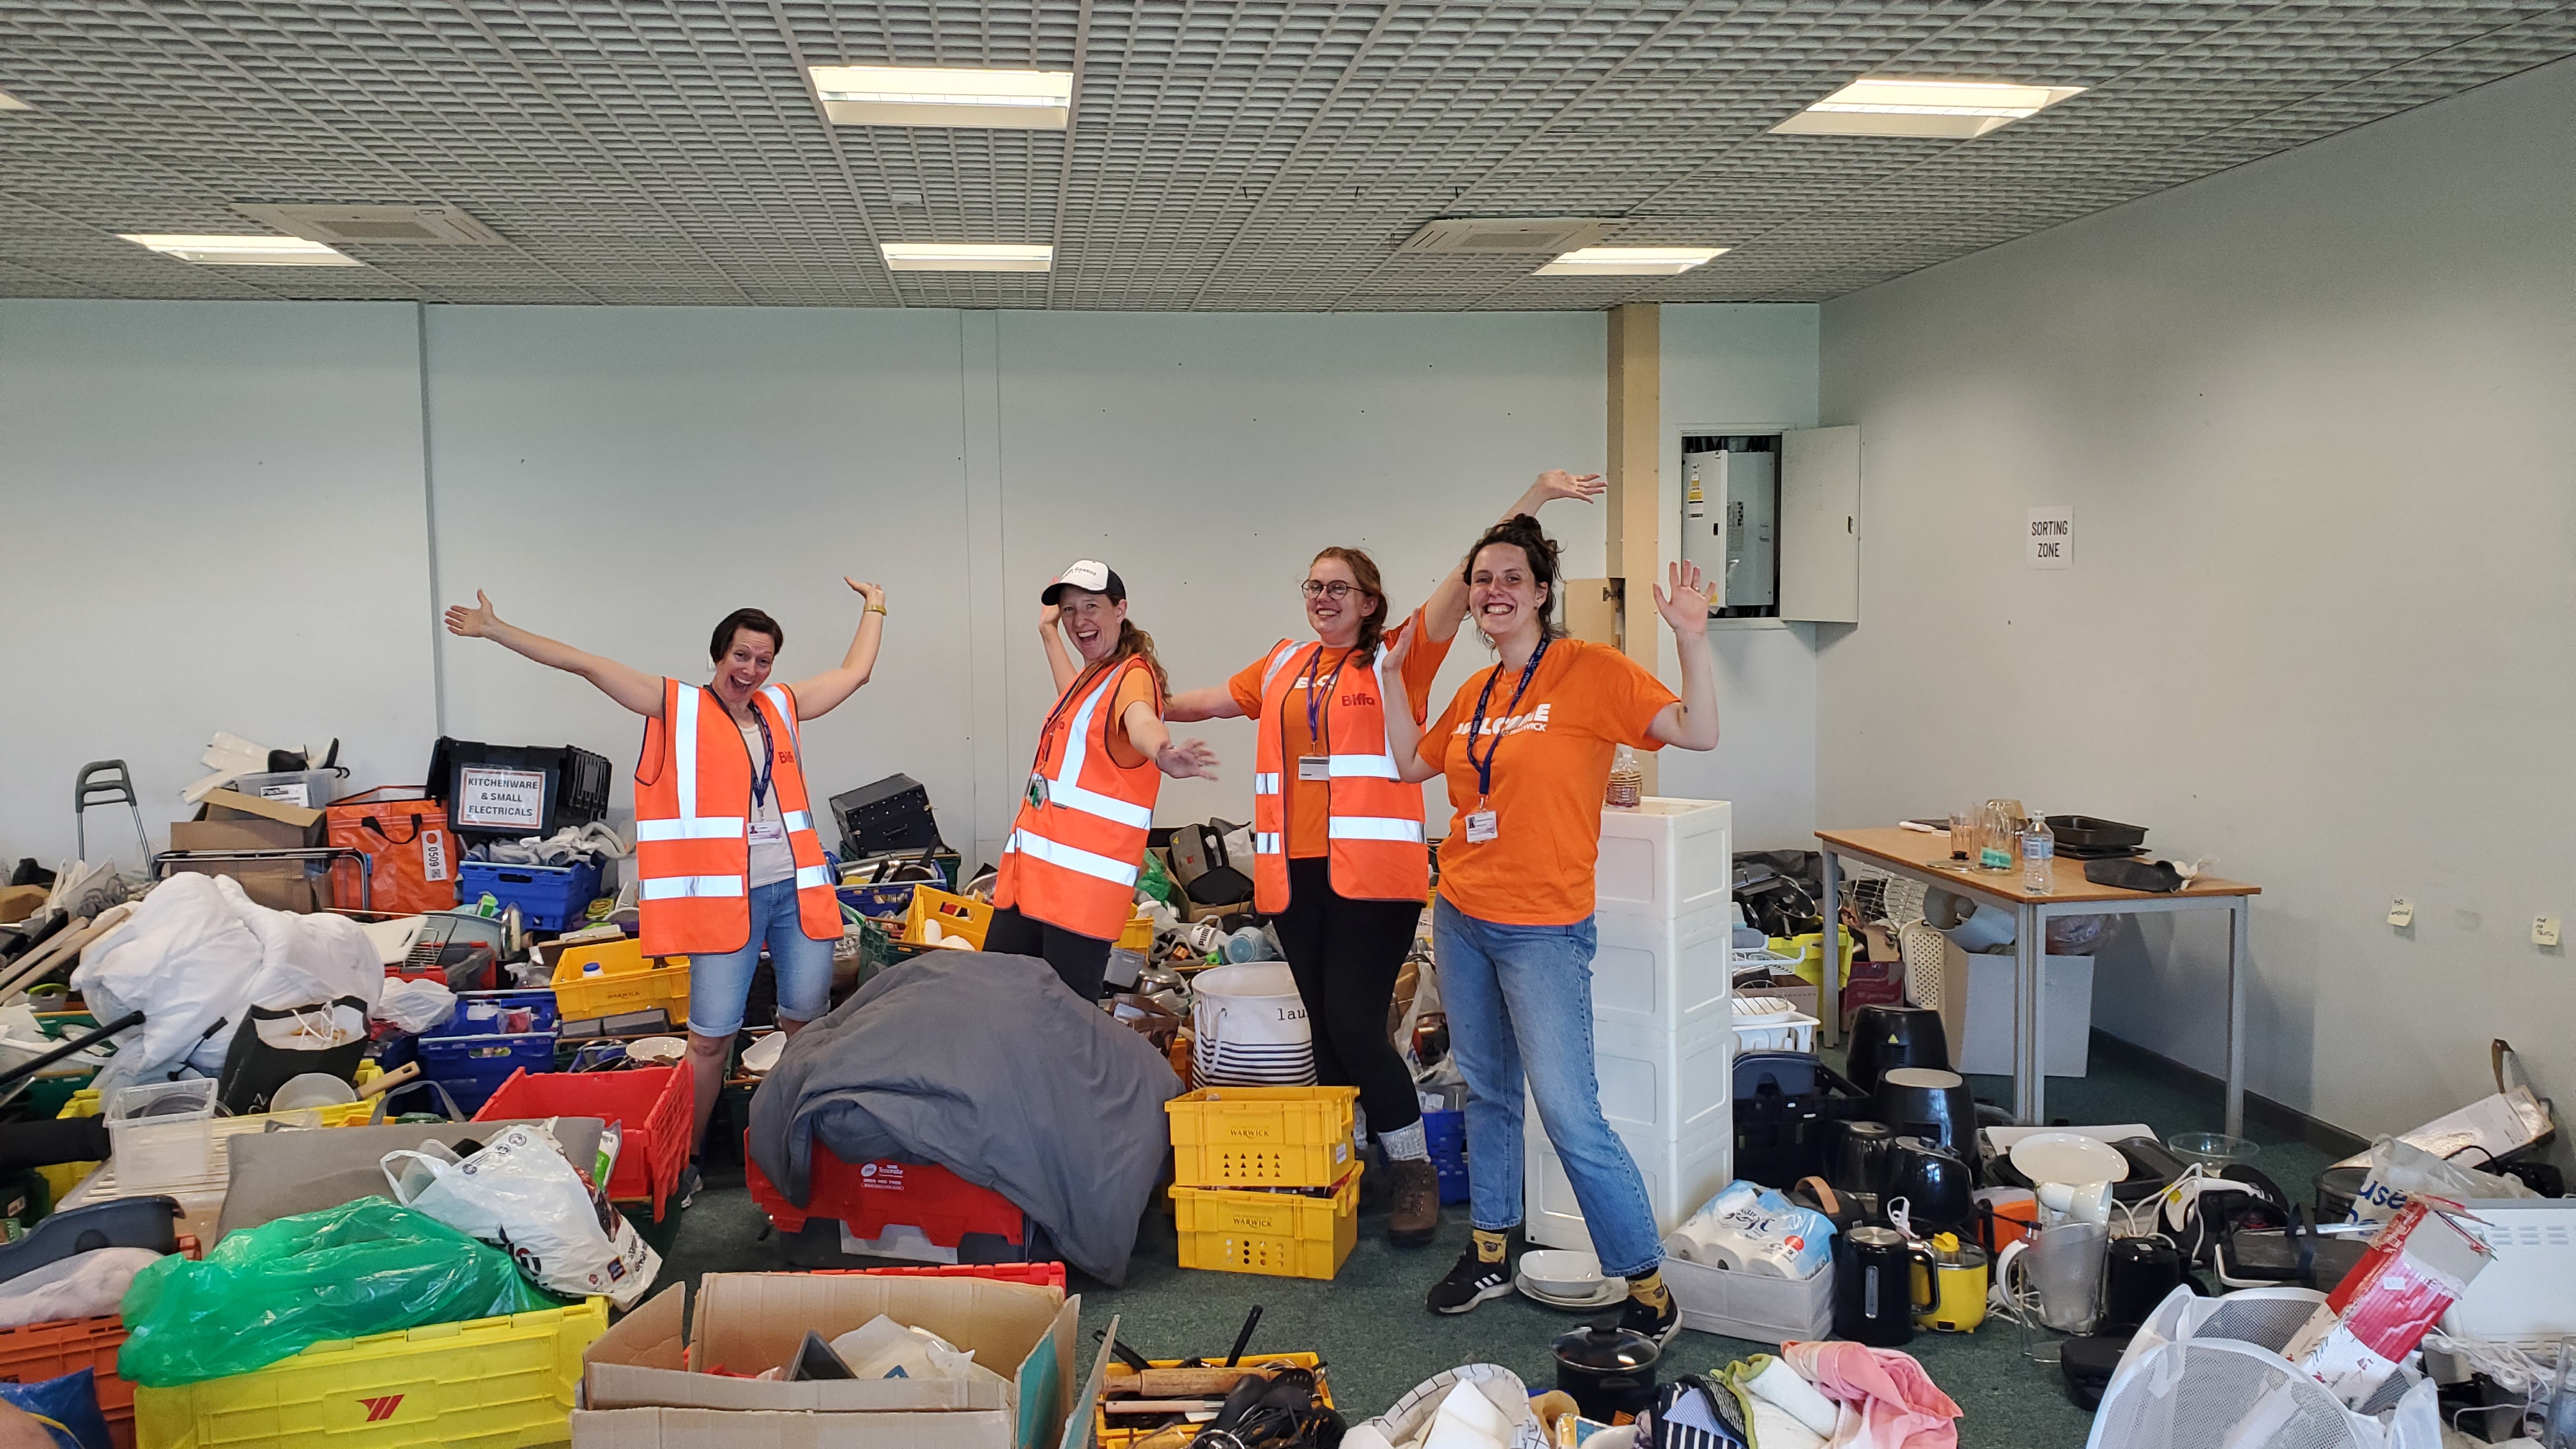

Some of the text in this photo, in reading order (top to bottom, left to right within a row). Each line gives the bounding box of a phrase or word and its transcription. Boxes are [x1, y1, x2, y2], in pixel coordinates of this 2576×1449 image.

[2031, 520, 2068, 536] SORTING
[2037, 542, 2060, 558] ZONE
[1341, 693, 1376, 707] Biffa
[468, 778, 539, 790] KITCHENWARE
[490, 792, 523, 802] SMALL
[469, 805, 533, 816] ELECTRICALS
[428, 847, 439, 867] 0509
[1198, 928, 1210, 946] PUMA
[1277, 1008, 1309, 1021] lau
[1230, 1129, 1269, 1139] WARWICK
[1233, 1217, 1273, 1229] WARWICK
